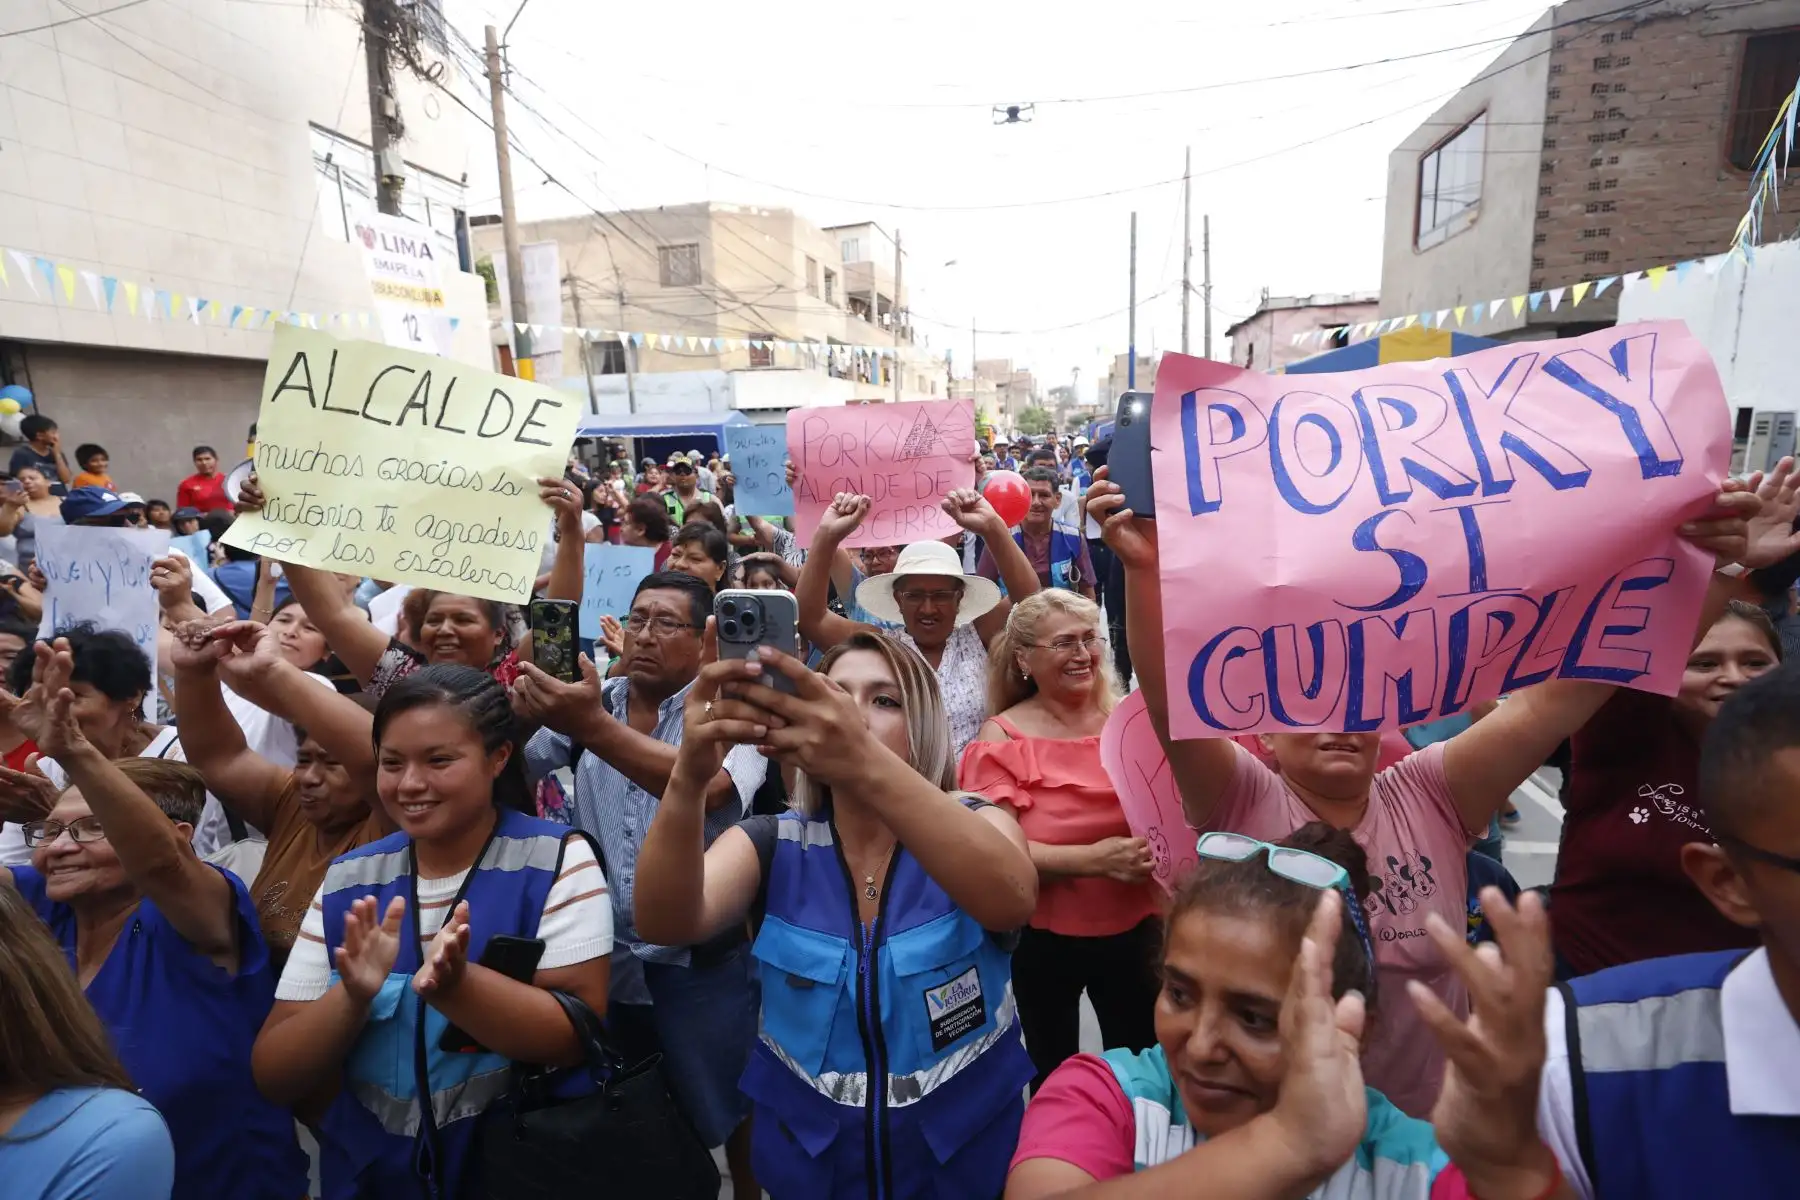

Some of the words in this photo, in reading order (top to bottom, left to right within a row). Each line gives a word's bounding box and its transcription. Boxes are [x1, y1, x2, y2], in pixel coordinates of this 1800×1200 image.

[380, 232, 434, 261] LIMA
[402, 312, 422, 342] 12
[271, 349, 562, 447] ALCALDE
[1181, 332, 1684, 517] PORKY
[803, 415, 904, 469] PORKY
[914, 470, 952, 500] DE
[246, 532, 307, 556] por
[1333, 500, 1522, 612] SI
[1187, 558, 1675, 733] CUMPLE
[928, 984, 978, 1011] VICTORIA
[951, 982, 963, 995] LA
[948, 1021, 972, 1039] VECINAL
